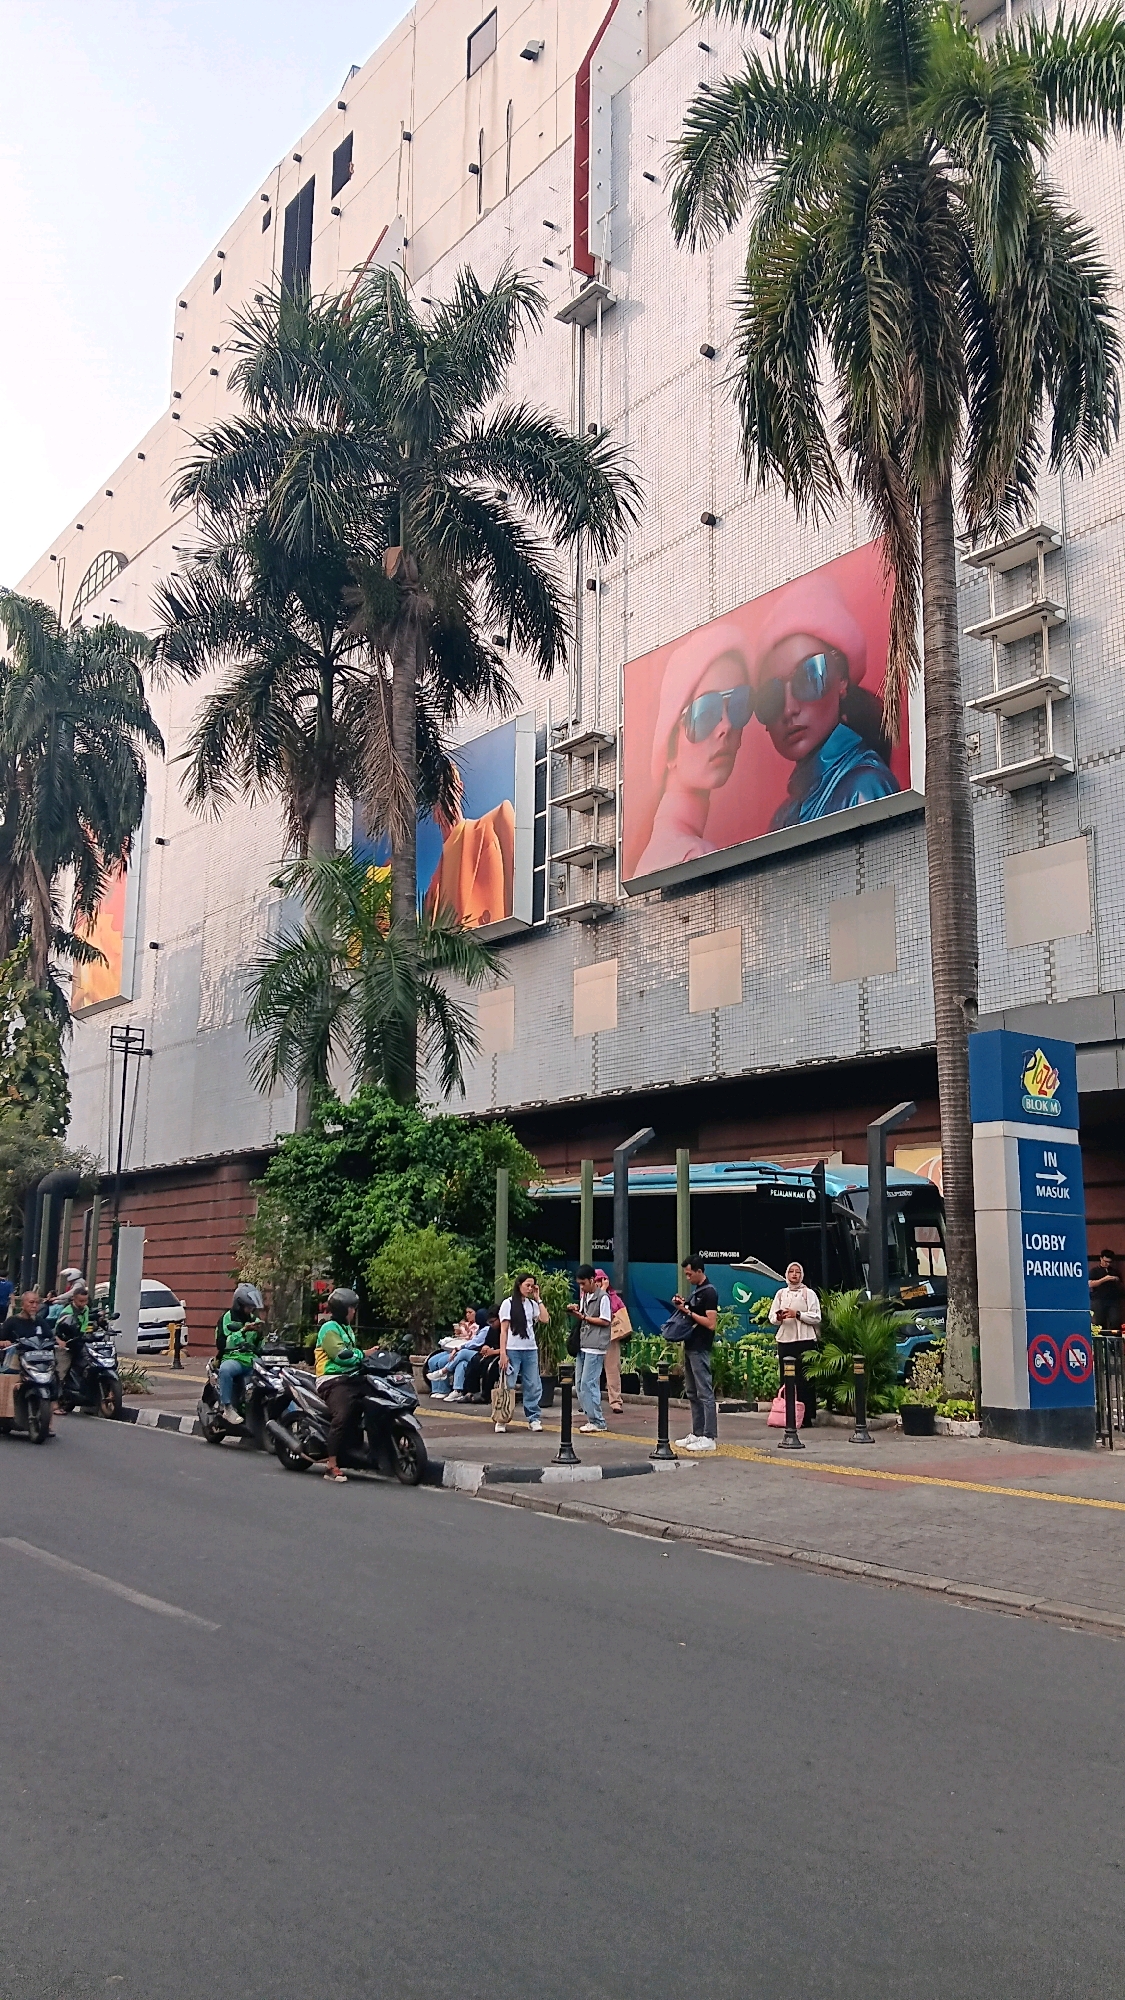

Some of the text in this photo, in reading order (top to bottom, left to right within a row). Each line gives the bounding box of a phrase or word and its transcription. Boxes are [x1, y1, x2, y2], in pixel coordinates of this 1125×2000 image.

[1020, 1049, 1060, 1096] Plaza
[1025, 1098, 1059, 1114] BLOK M
[1043, 1150, 1058, 1168] IN
[770, 1189, 806, 1199] PEJALAN KAKI
[1035, 1184, 1071, 1200] MASUK
[1025, 1233, 1067, 1251] LOBBY
[1026, 1259, 1083, 1278] PARKING
